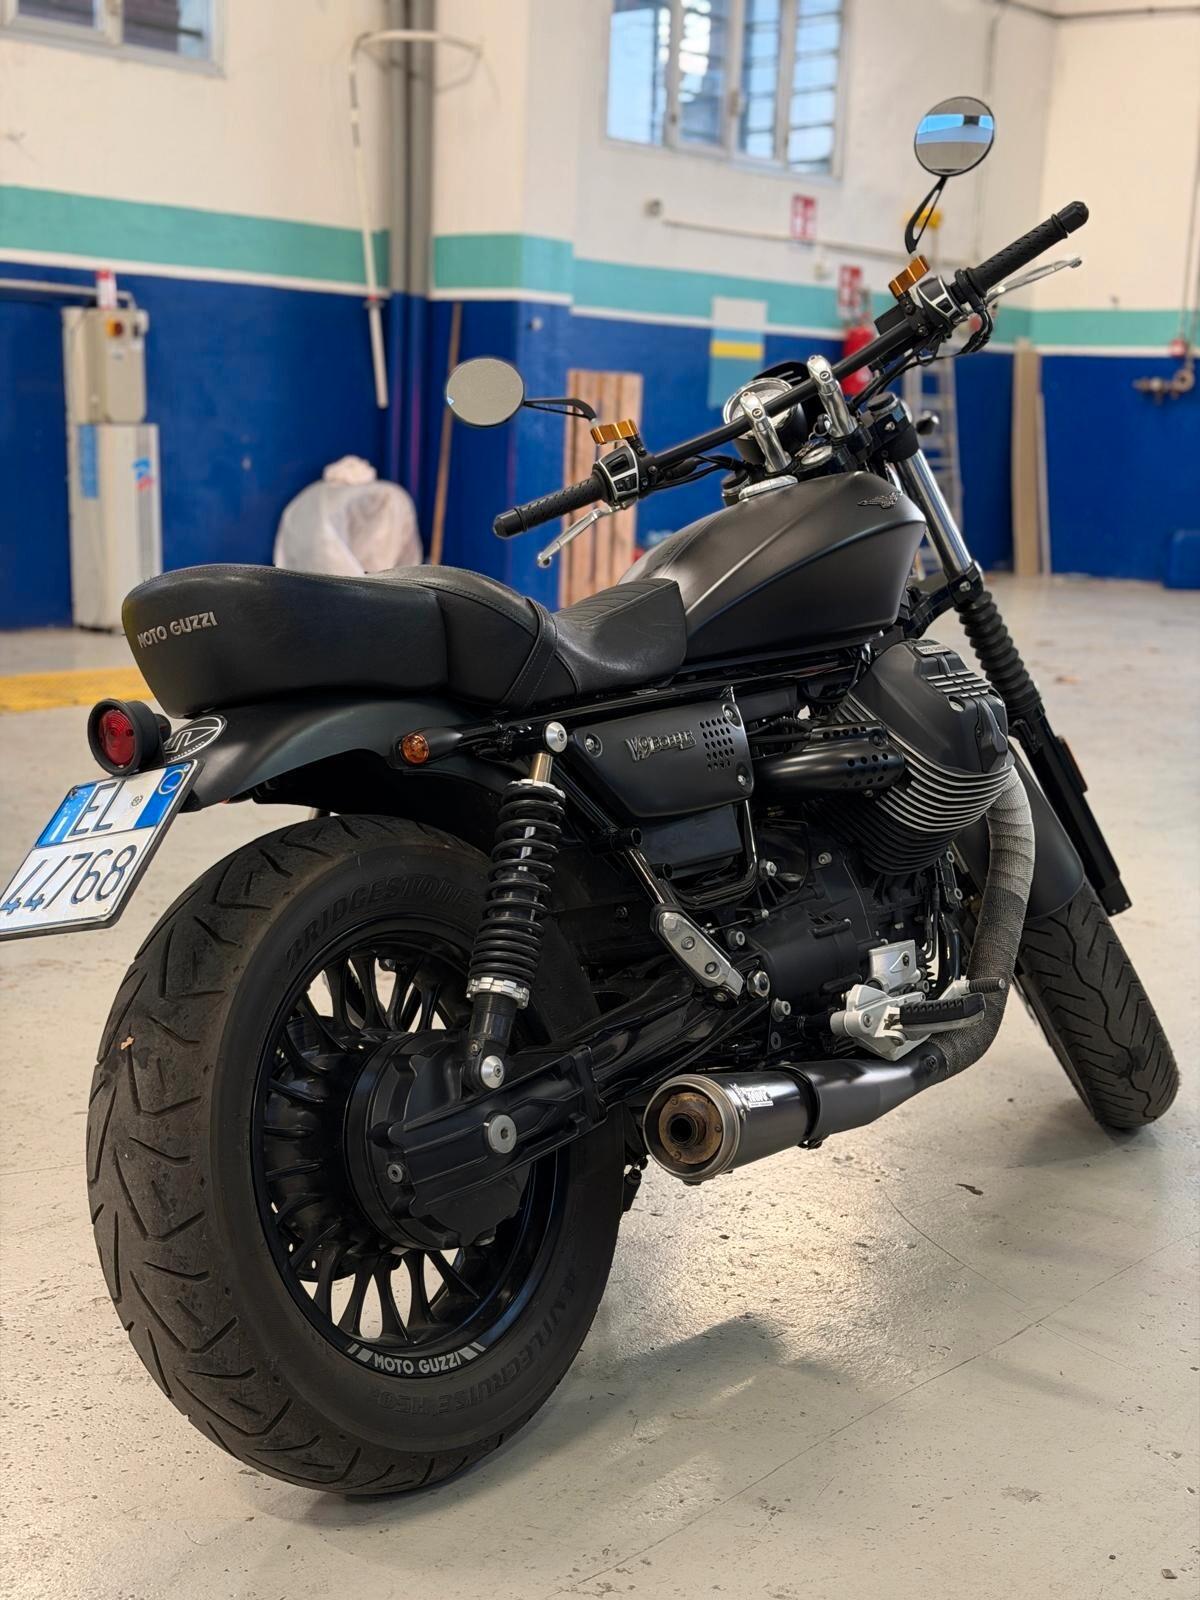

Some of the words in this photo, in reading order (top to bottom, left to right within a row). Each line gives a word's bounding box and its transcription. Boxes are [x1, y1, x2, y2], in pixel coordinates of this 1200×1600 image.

[136, 625, 168, 649] MOTO
[169, 611, 219, 636] GUZZI
[68, 779, 127, 837] EL
[0, 844, 138, 916] 44768
[373, 1352, 414, 1375] MOTO
[418, 1352, 462, 1374] GUZZI
